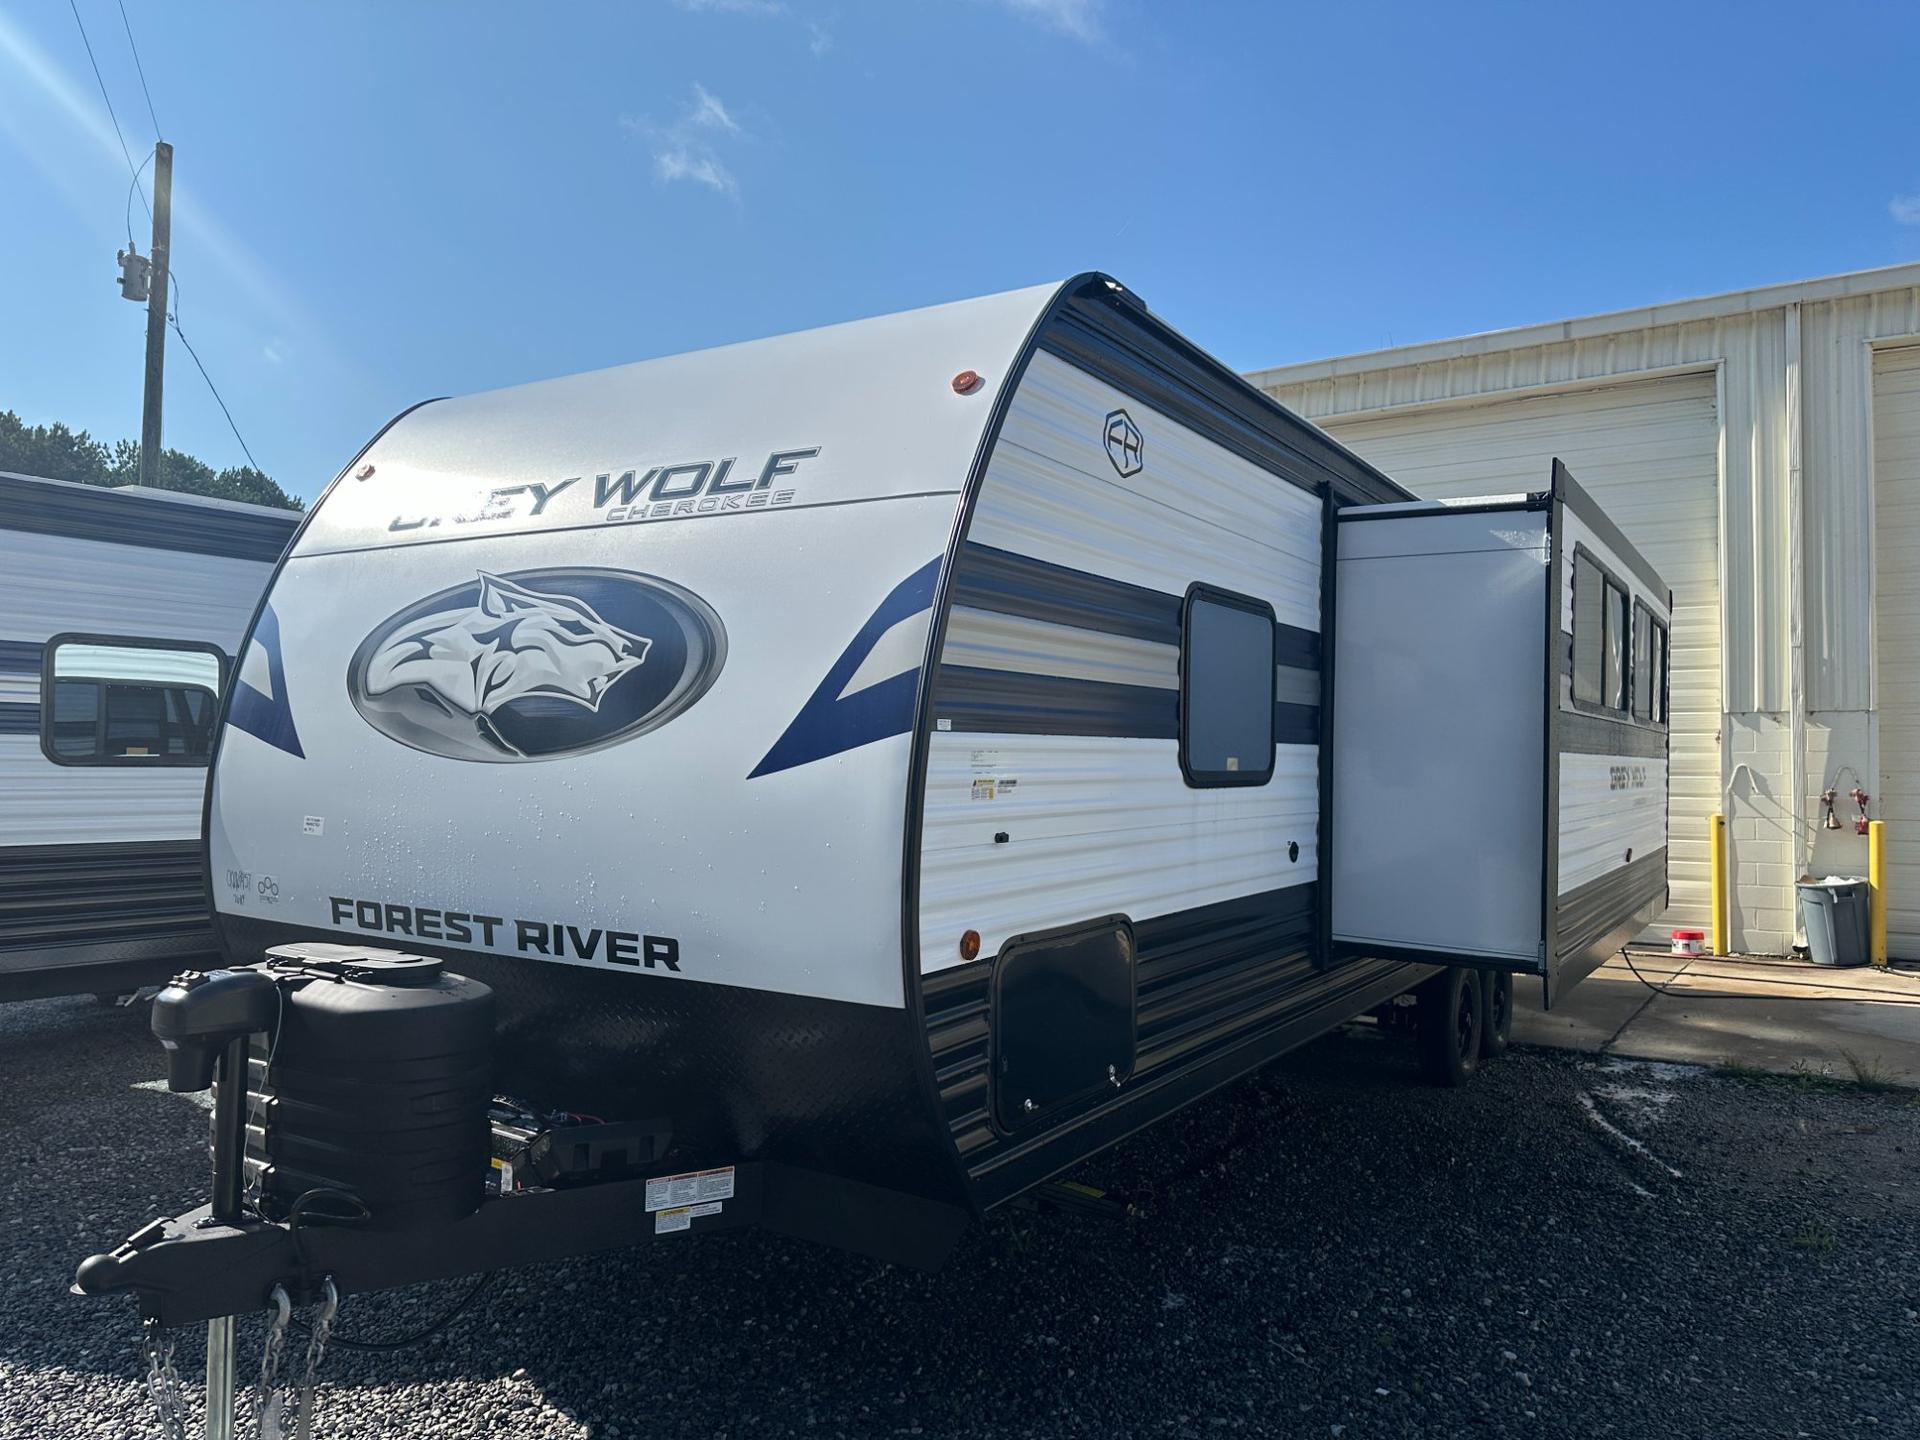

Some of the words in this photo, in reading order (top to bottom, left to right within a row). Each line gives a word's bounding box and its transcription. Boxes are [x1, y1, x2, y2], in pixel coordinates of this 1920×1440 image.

[388, 477, 582, 531] EY
[593, 445, 823, 509] WOLF
[606, 488, 796, 522] CHEROKEE
[328, 896, 503, 948] FOREST
[514, 918, 682, 972] RIVER
